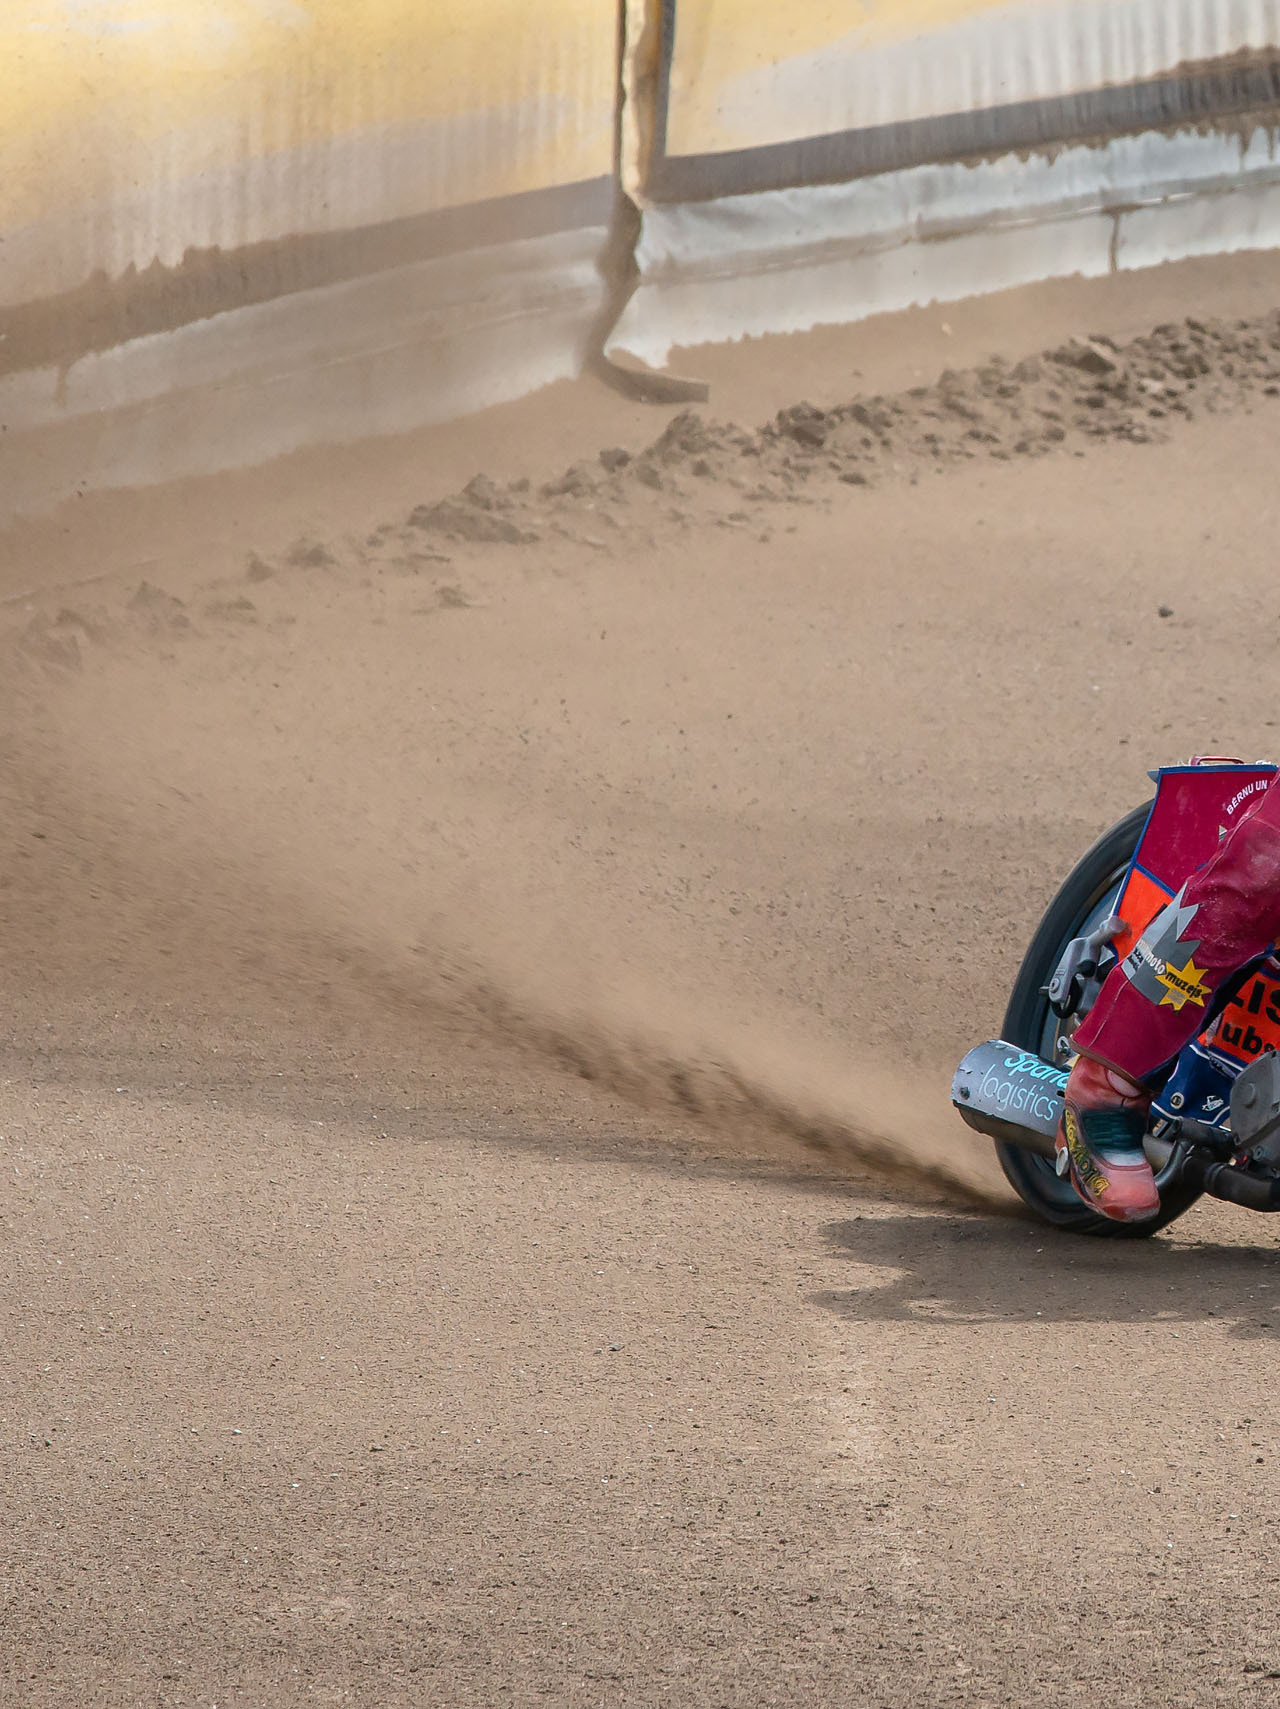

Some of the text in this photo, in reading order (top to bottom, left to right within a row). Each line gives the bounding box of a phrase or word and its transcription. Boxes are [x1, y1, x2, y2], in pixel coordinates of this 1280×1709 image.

[1255, 779, 1268, 791] UN
[1165, 971, 1203, 999] muzejs
[978, 1063, 1059, 1121] logistics
